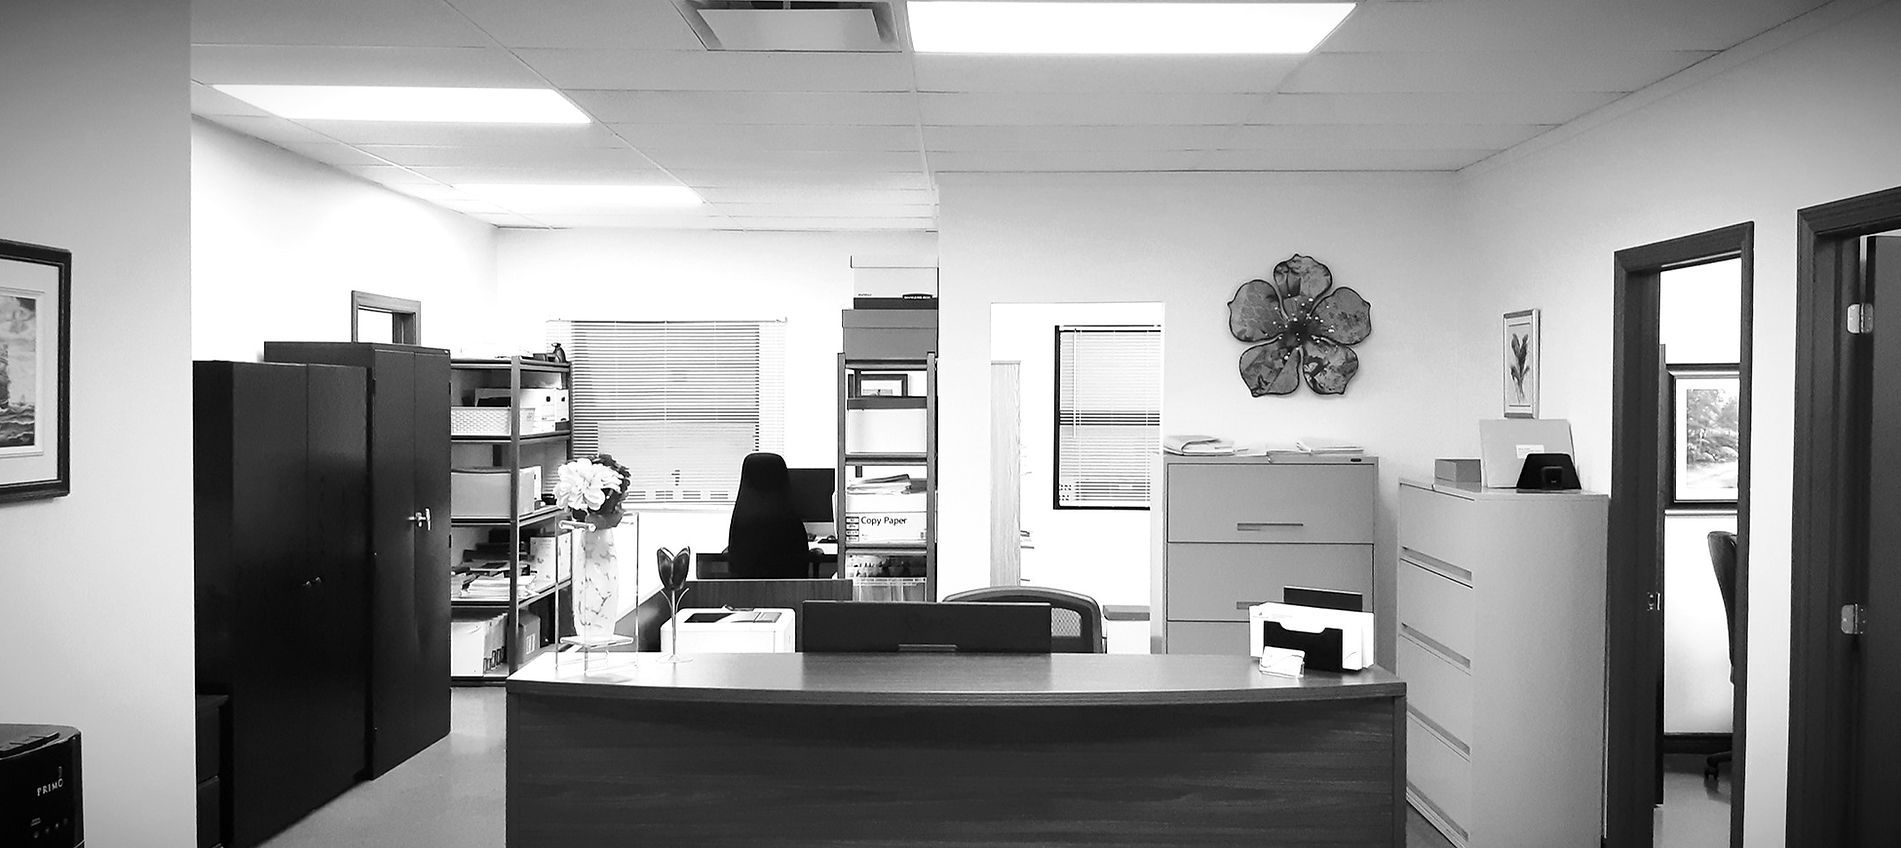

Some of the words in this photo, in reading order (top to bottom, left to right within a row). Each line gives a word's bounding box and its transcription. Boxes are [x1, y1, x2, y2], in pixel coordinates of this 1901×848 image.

[861, 516, 882, 526] Copy
[884, 516, 907, 526] Paper
[37, 778, 64, 797] PRIMO
